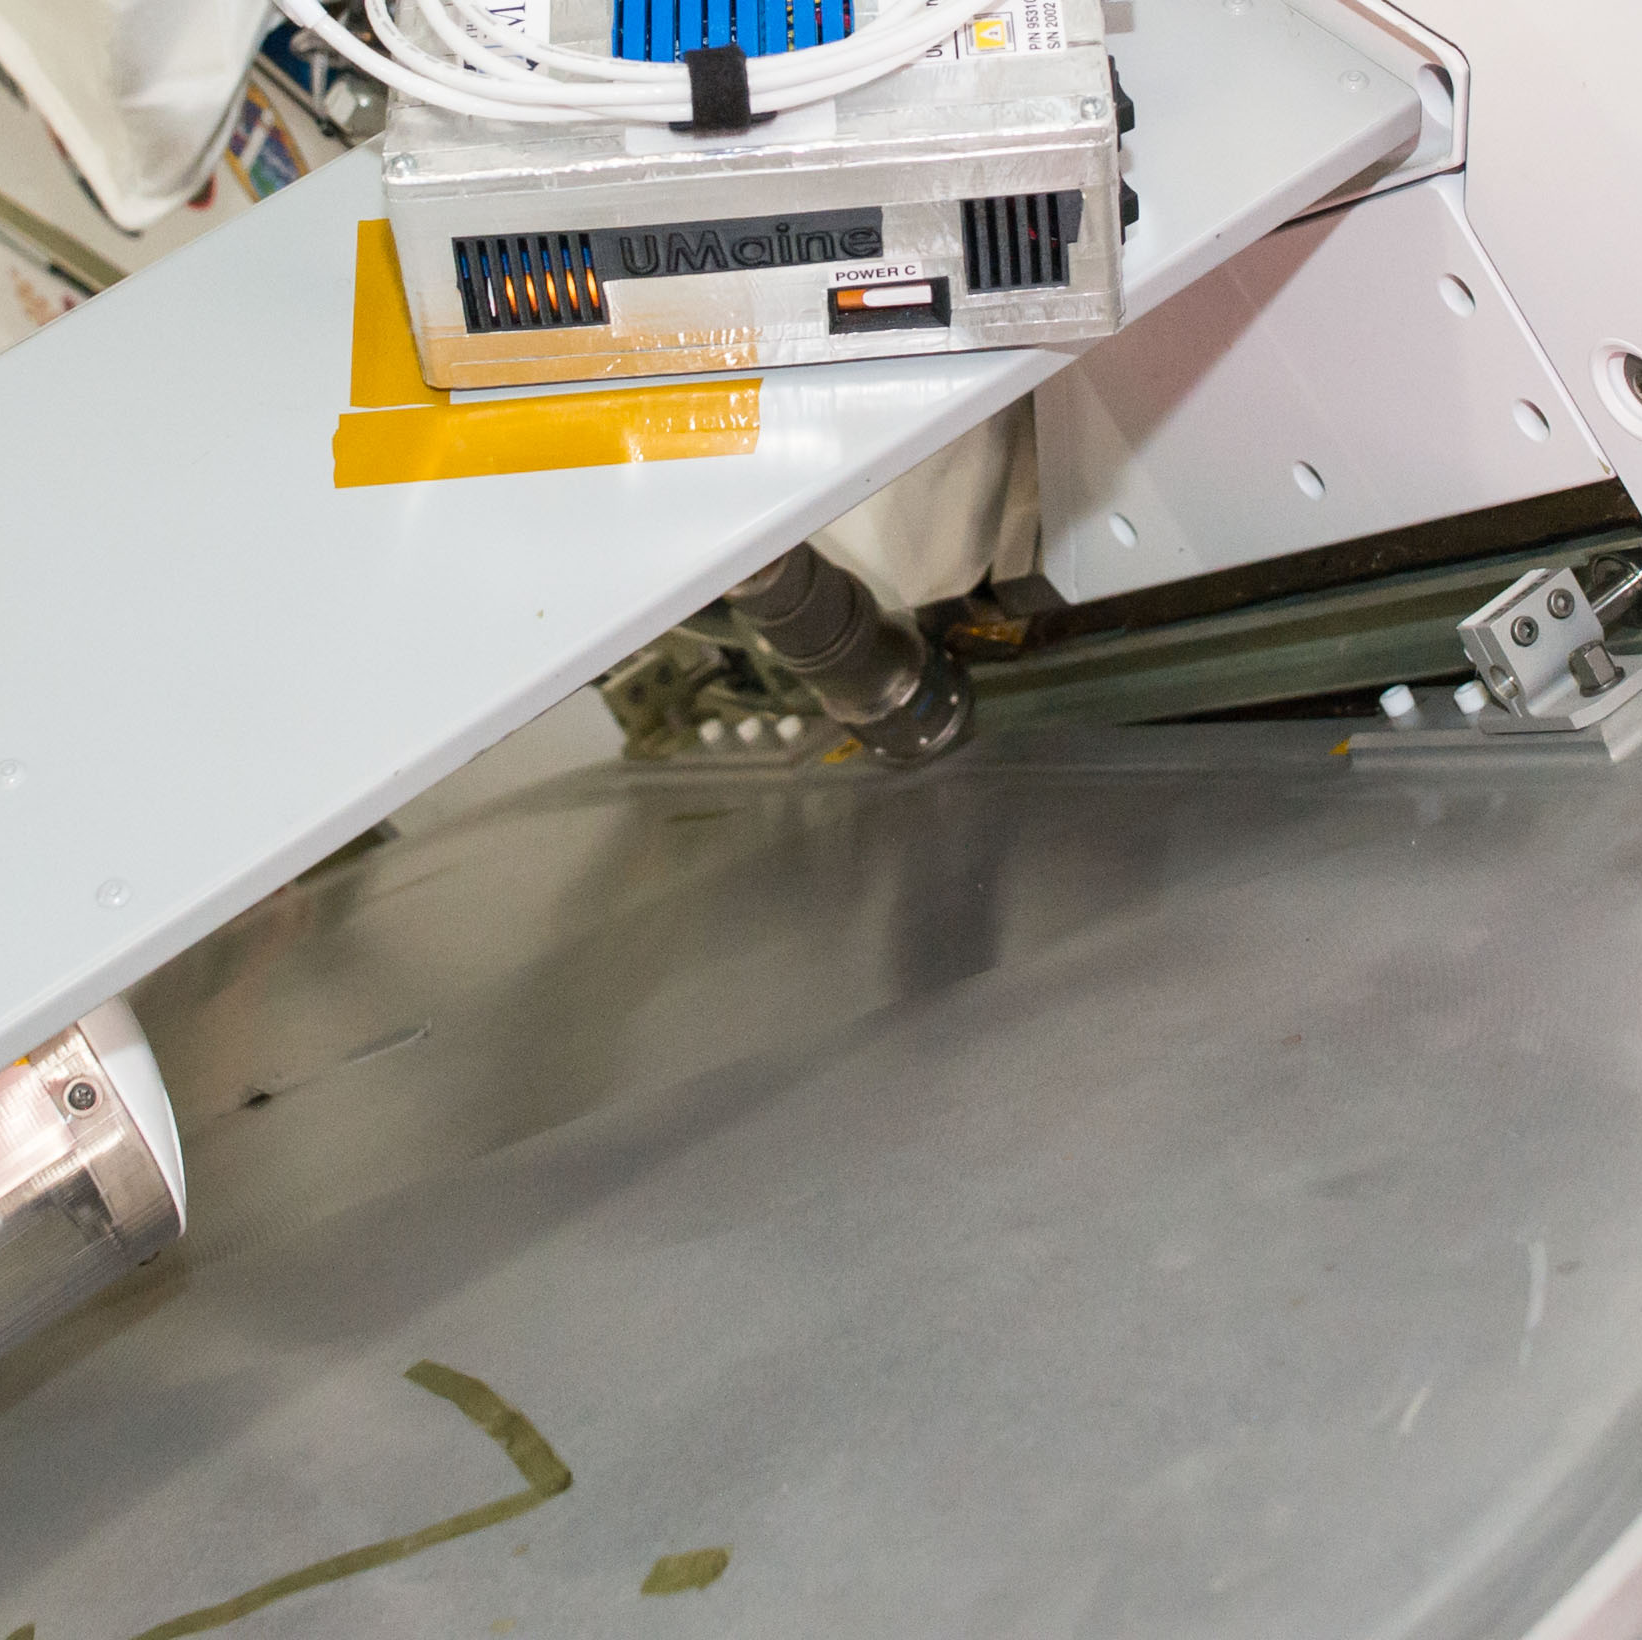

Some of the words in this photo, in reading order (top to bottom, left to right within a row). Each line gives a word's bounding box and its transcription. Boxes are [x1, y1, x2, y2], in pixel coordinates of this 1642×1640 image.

[1043, 1, 1058, 29] 2002
[1028, 31, 1042, 51] P/N
[1044, 29, 1061, 50] S/N
[618, 221, 883, 277] UMaine
[834, 265, 899, 283] POWER
[904, 264, 918, 276] C
